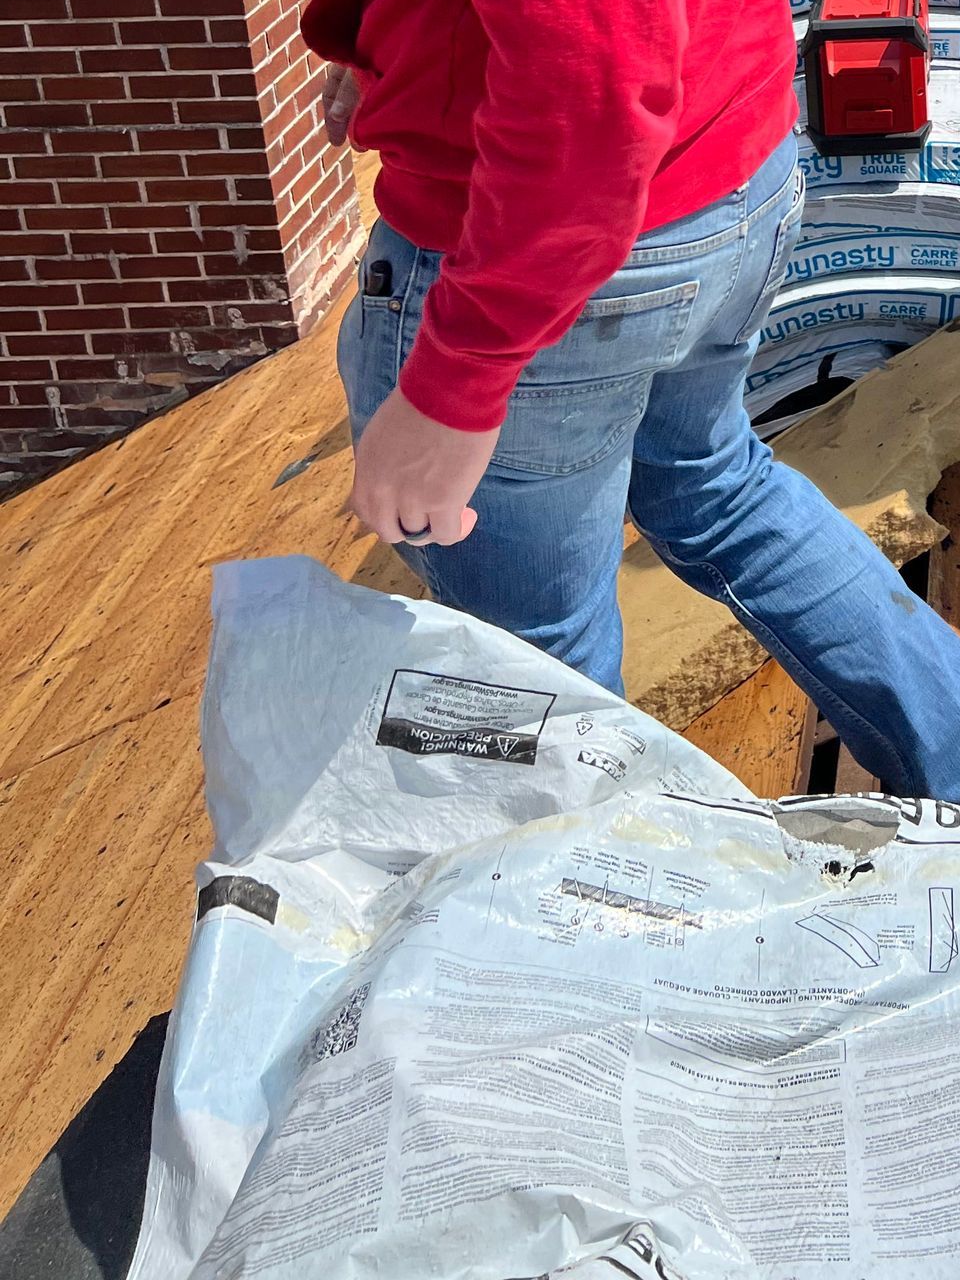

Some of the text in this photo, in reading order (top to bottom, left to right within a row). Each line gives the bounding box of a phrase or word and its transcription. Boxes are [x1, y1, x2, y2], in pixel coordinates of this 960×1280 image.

[860, 153, 906, 165] TRUE
[860, 166, 906, 175] SQUARE
[911, 247, 958, 259] CARRÉ
[911, 258, 958, 267] COMPLET
[879, 303, 927, 315] CARRÉ
[432, 679, 518, 698] www.P65Warnings.ca.gov
[442, 700, 477, 712] Causante
[497, 700, 518, 708] Otros
[478, 707, 499, 715] Como
[414, 713, 432, 723] Harm
[411, 727, 492, 742] PRECAUCIÓN
[421, 741, 488, 754] WARNING!
[654, 978, 690, 993] ADÉQUAT
[714, 985, 798, 997] CLAVADO CORRECTO
[693, 988, 730, 1000] CLOUAGE
[670, 1060, 687, 1074] INICIO
[512, 1184, 531, 1192] TECHO
